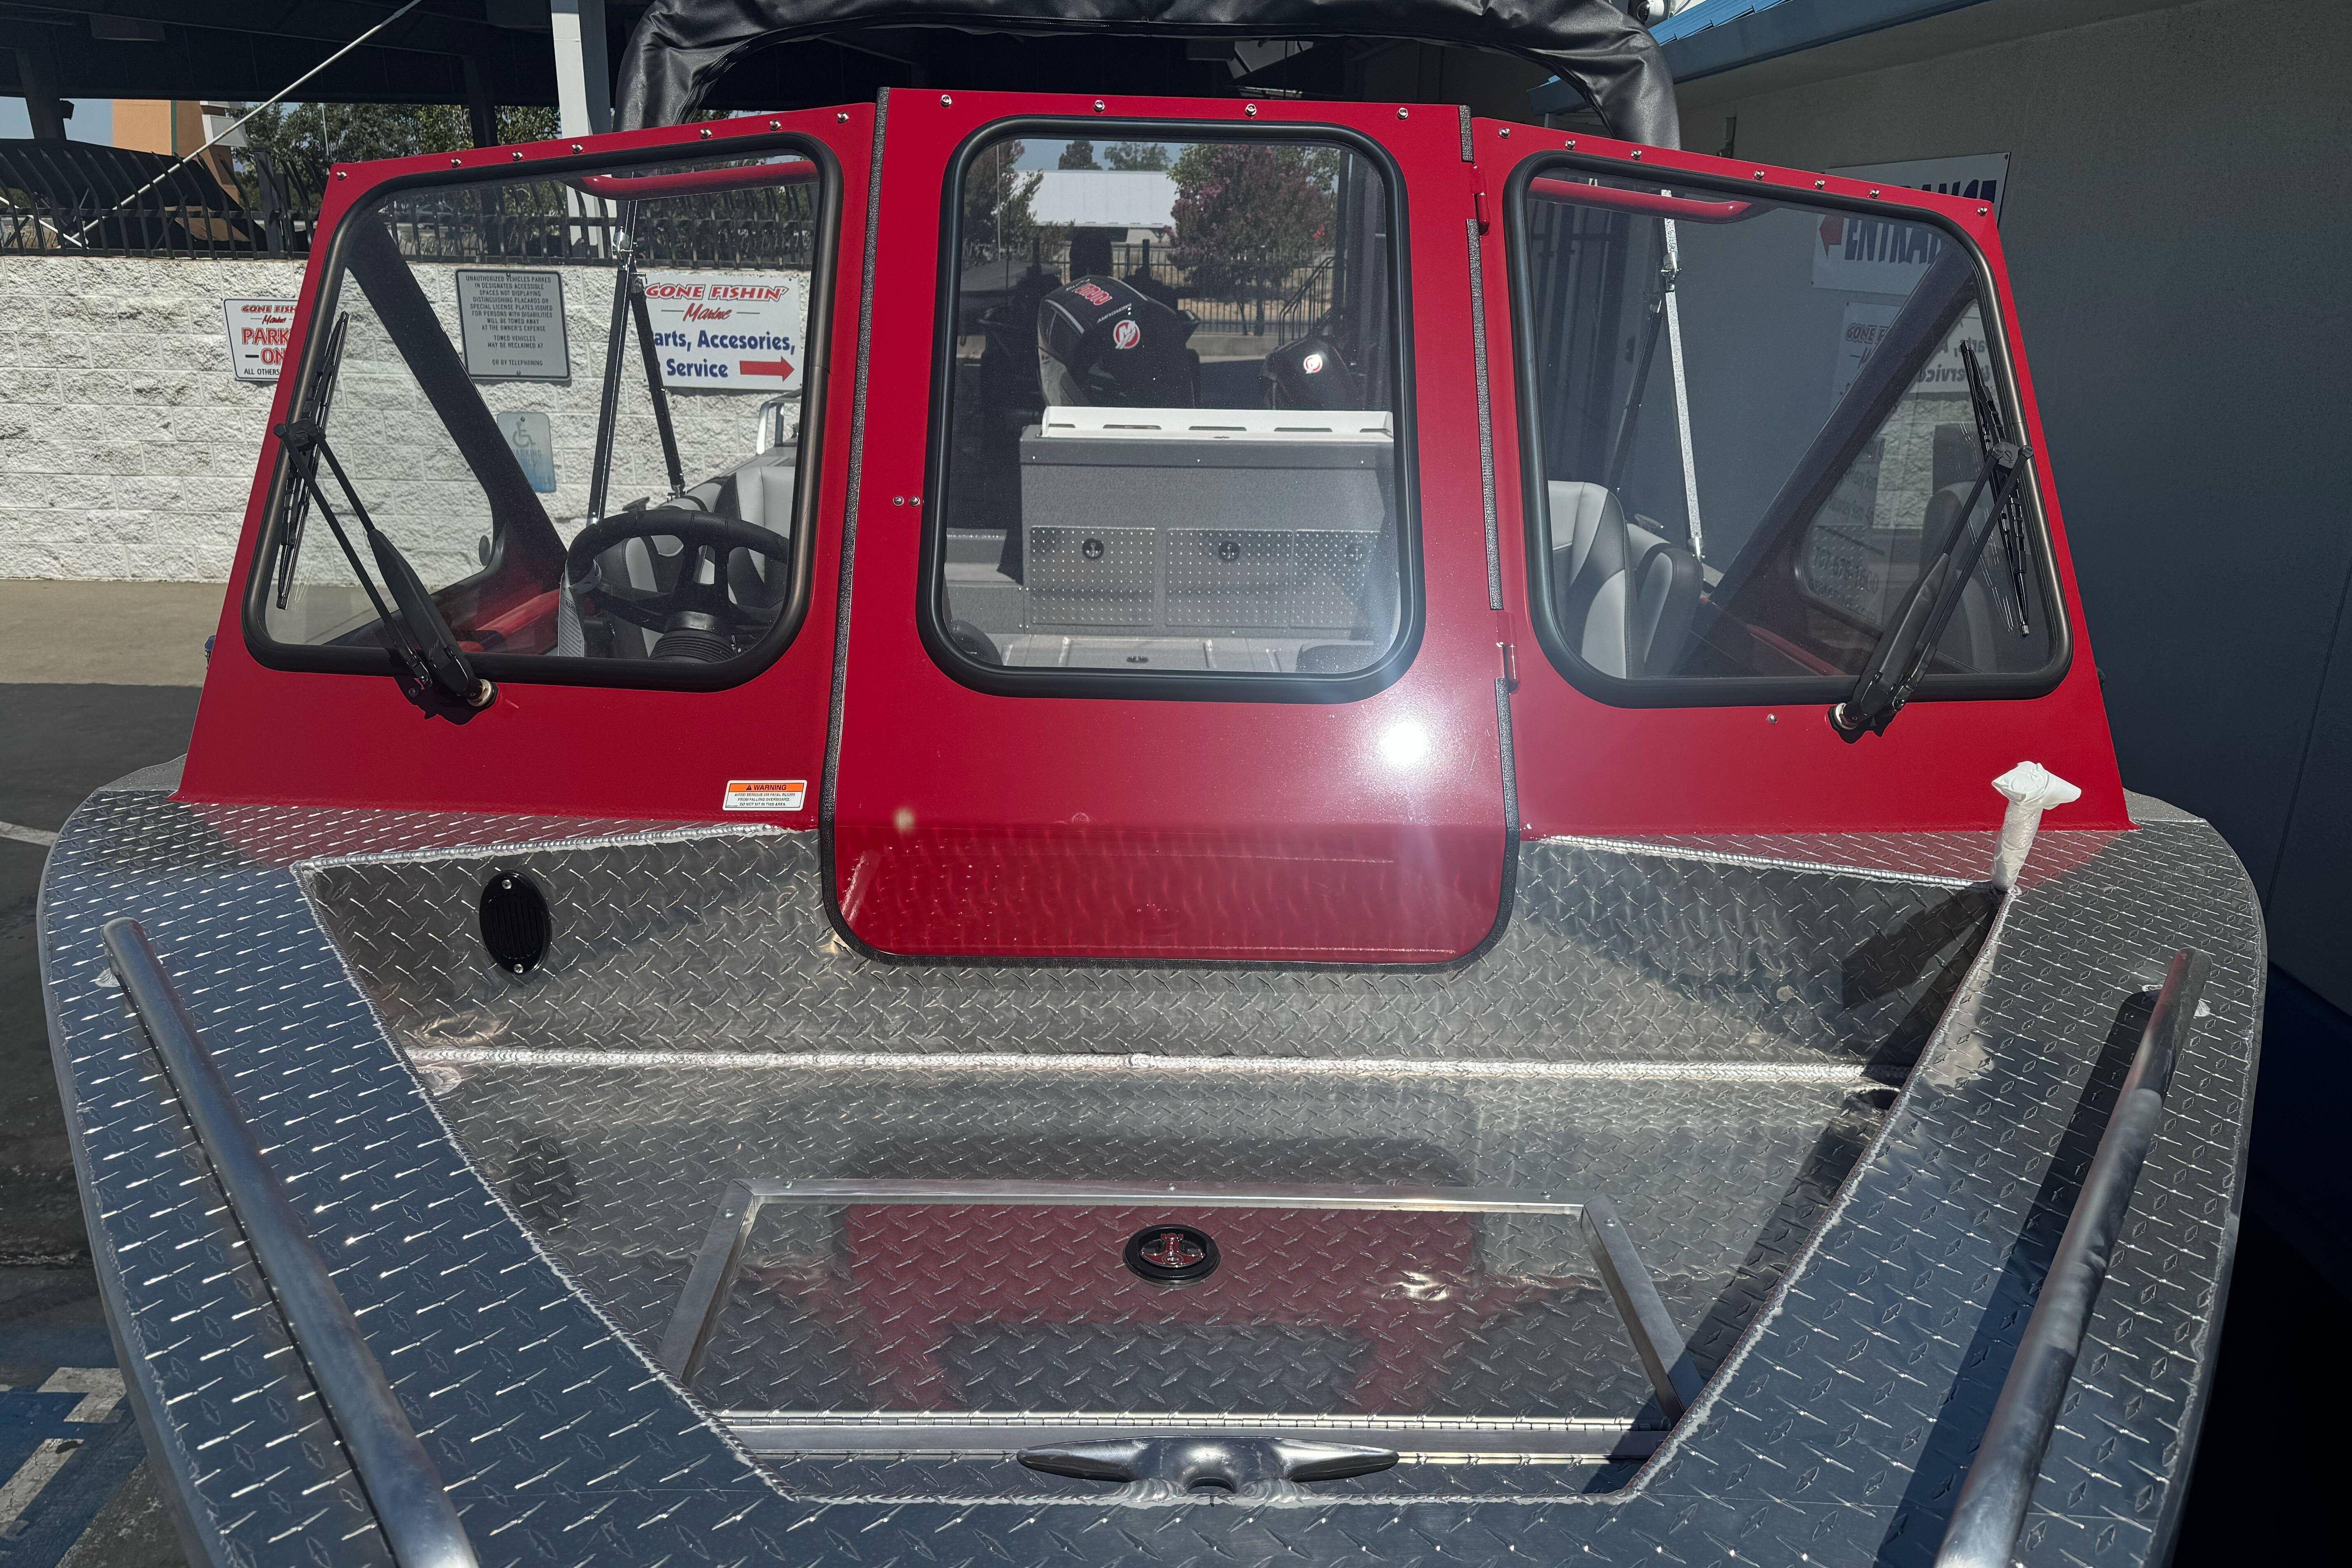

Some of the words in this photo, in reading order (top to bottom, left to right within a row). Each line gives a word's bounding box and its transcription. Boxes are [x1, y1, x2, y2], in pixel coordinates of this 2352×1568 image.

[645, 283, 705, 300] GONE
[708, 285, 789, 302] FISHIN'
[241, 305, 272, 313] GONE
[683, 303, 732, 322] Marine
[1097, 303, 1132, 324] MERCURY
[654, 330, 691, 352] arts,
[698, 330, 795, 355] Accesories,
[1845, 322, 1878, 344] GONE
[667, 358, 728, 377] Service
